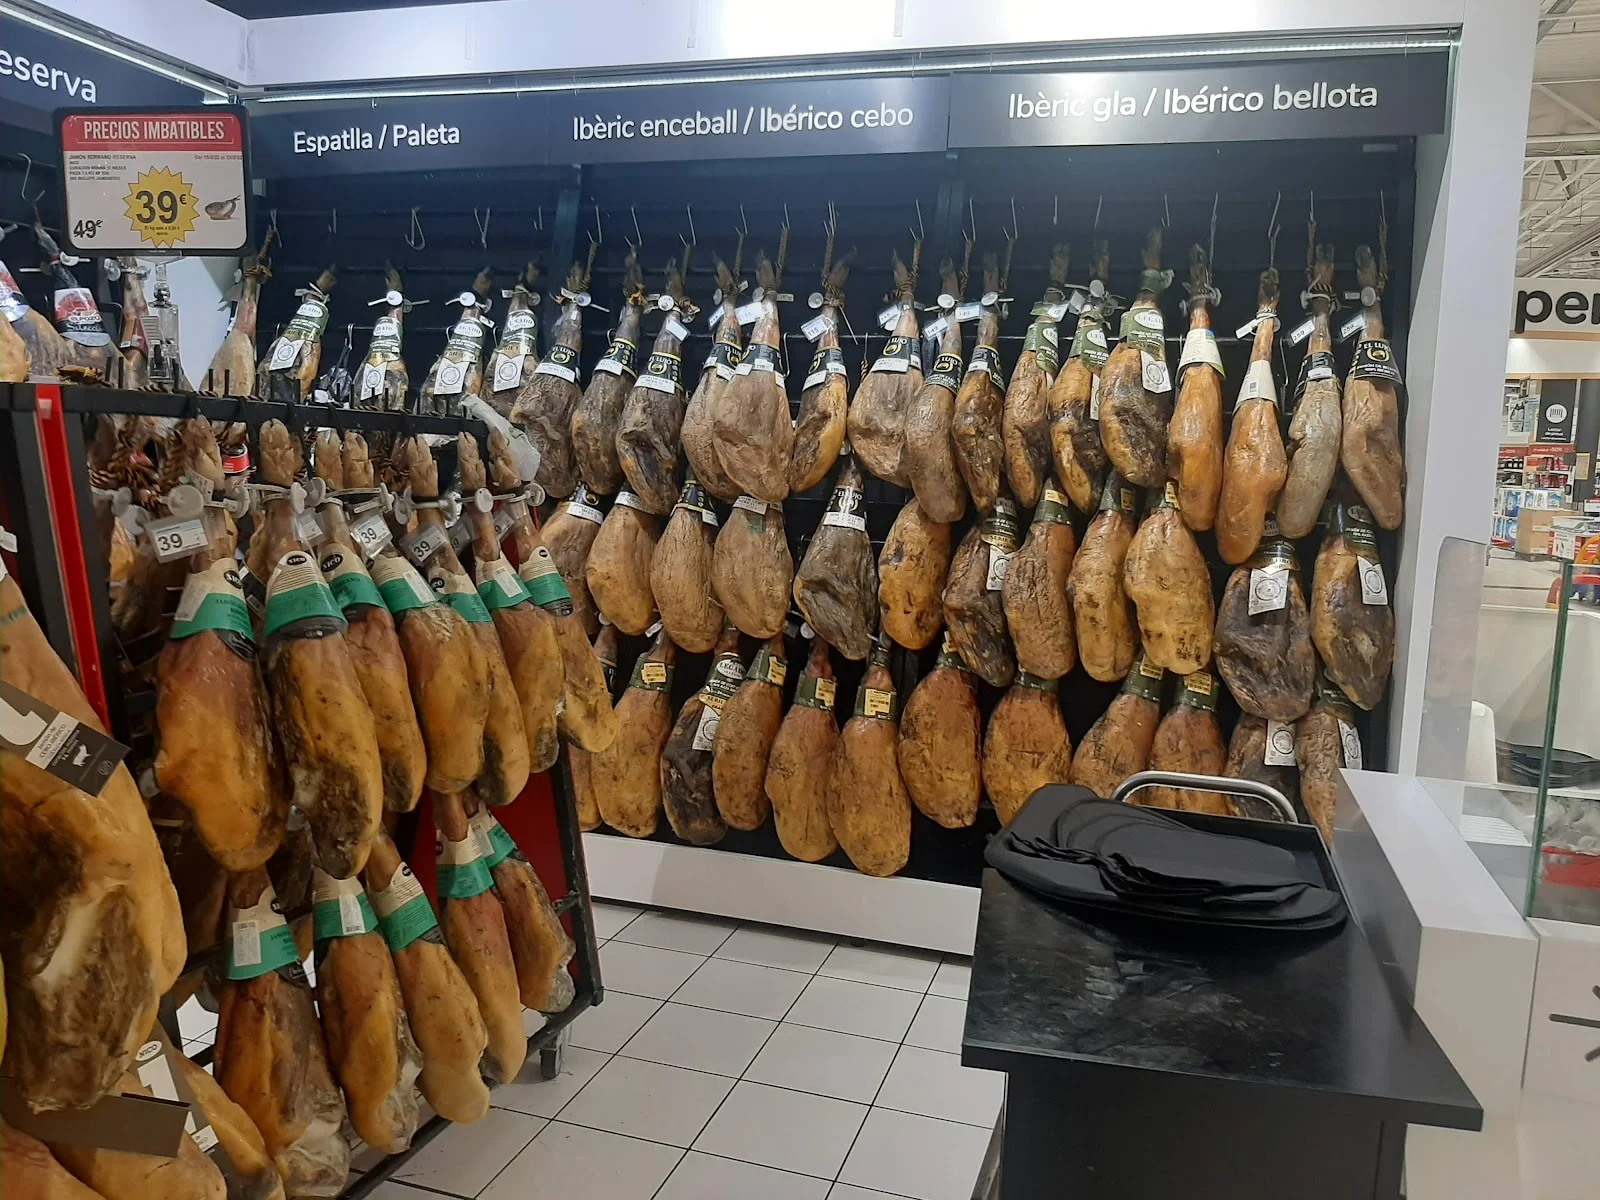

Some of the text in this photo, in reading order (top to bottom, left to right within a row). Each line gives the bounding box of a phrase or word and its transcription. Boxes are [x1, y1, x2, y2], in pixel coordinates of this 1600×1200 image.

[0, 49, 96, 104] eserva
[1008, 82, 1379, 123] Ibèric gla / Ibérico bellota
[83, 120, 225, 140] PRECIOS IMBATIBLES
[572, 101, 914, 141] Ibèric enceball / Ibérico cebo
[293, 122, 461, 157] Espatlla / Paleta
[157, 532, 183, 552] 39
[360, 527, 377, 545] 39
[413, 539, 432, 558] 39
[138, 1043, 158, 1059] NICO
